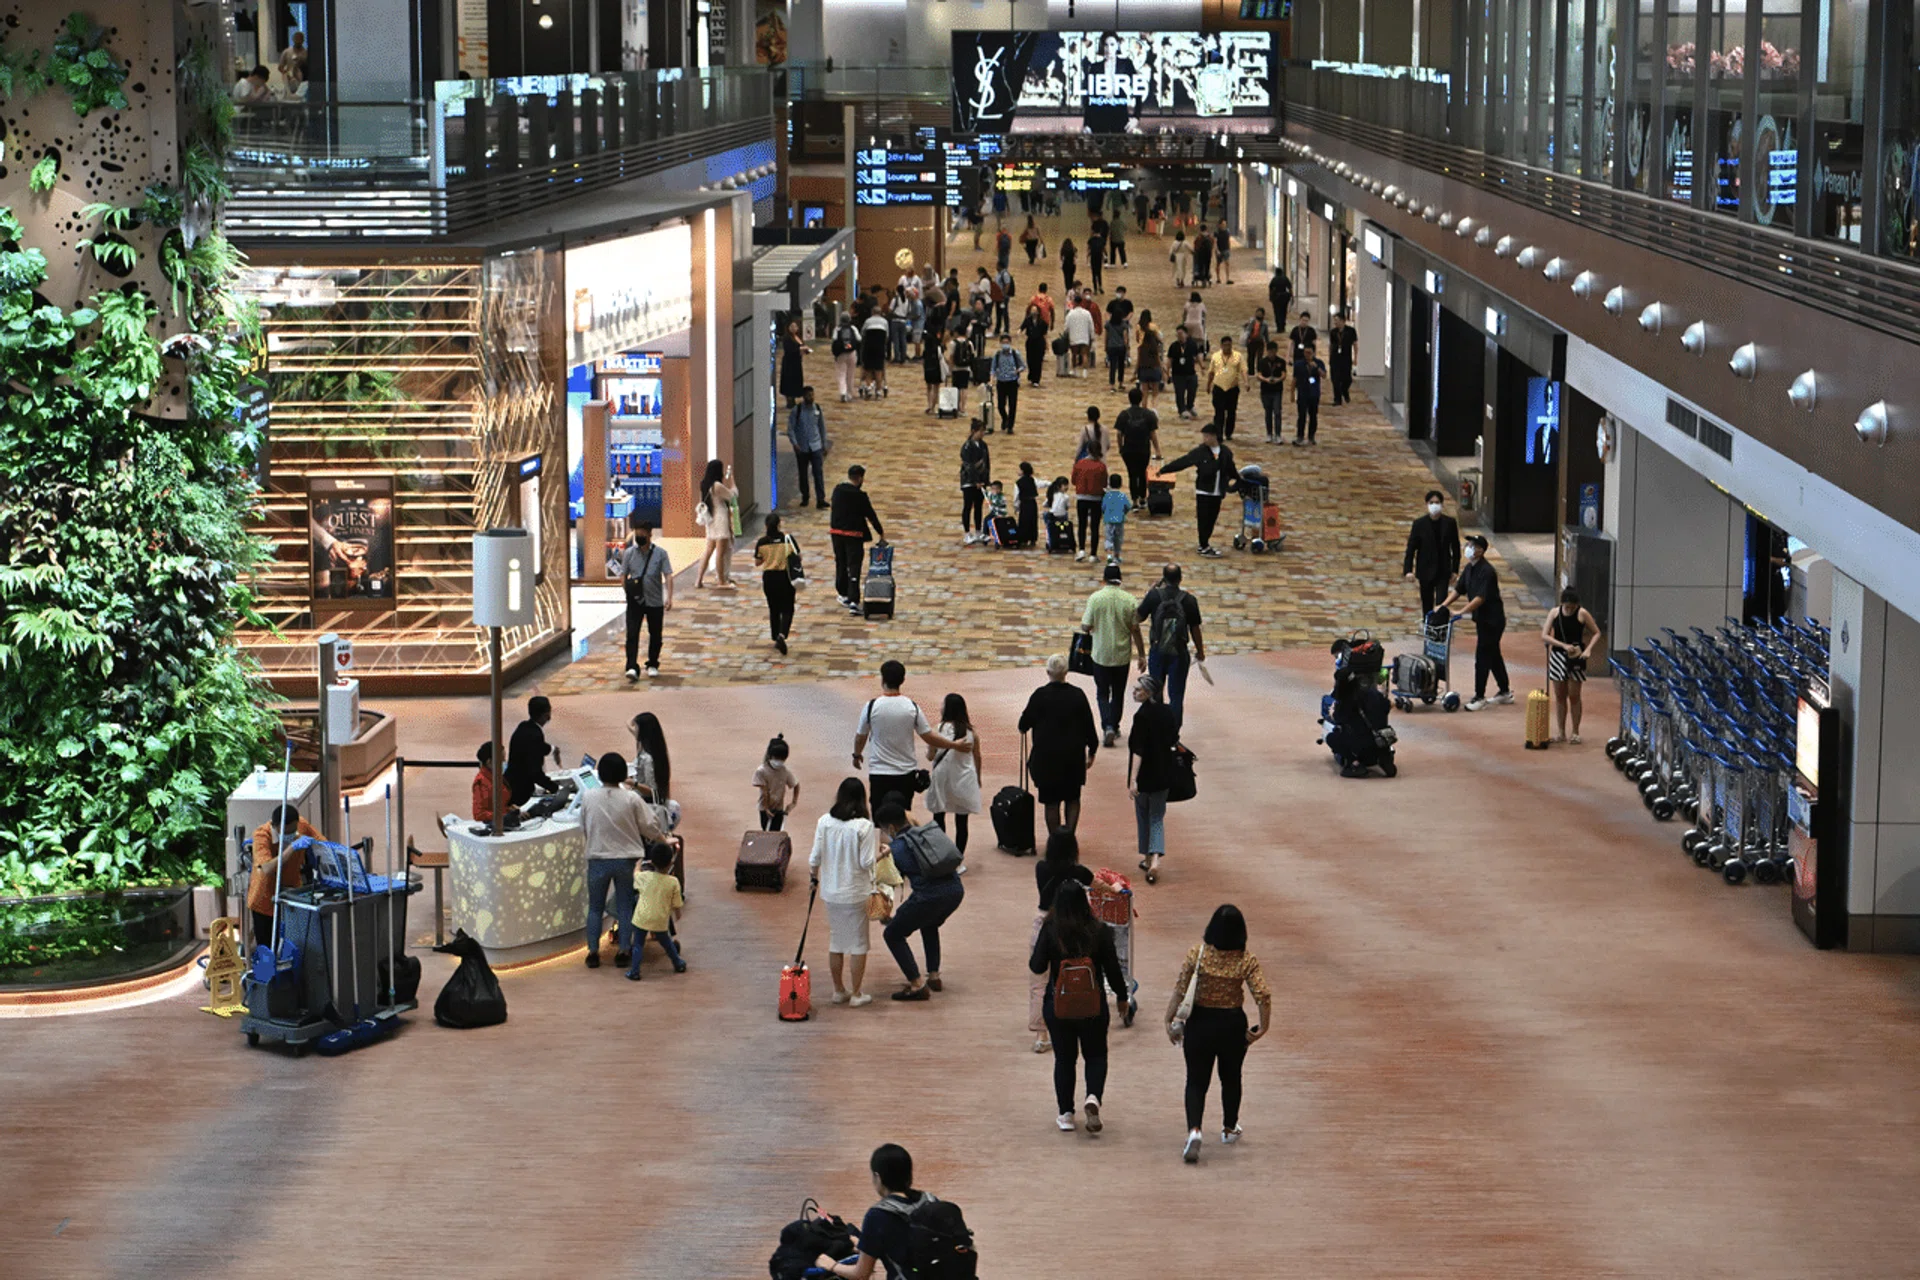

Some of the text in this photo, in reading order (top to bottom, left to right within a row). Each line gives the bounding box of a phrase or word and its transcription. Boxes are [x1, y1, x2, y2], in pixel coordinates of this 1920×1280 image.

[905, 152, 924, 162] Food
[888, 172, 917, 183] Lounges
[888, 192, 932, 202] Prayer Room
[605, 358, 661, 369] MARTELL
[328, 512, 376, 530] QUEST
